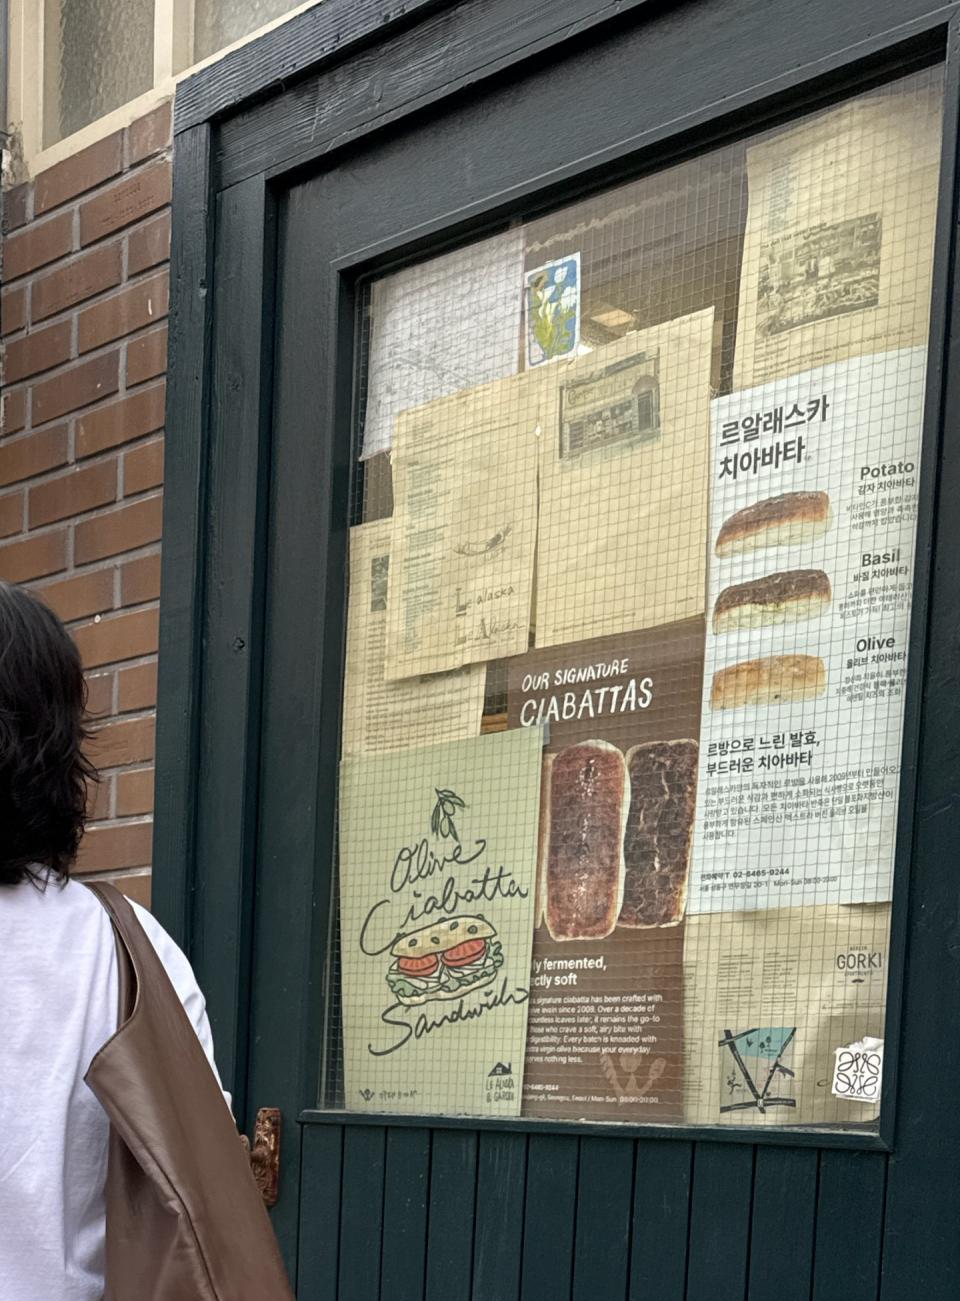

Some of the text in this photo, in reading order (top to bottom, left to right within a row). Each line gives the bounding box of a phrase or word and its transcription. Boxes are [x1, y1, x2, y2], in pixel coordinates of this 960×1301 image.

[720, 395, 829, 446] 르알래스카
[718, 437, 806, 479] 치아바타
[861, 462, 914, 480] Potato
[858, 478, 915, 495] 감자 치아바타
[862, 548, 900, 567] Basil
[854, 566, 908, 582] 바질 치아바타
[856, 636, 895, 652] Olive
[847, 651, 906, 669] 올리브 치아바타
[522, 658, 629, 692] OUR SIGNATURE
[520, 678, 653, 727] CIABATTAS
[707, 730, 820, 757] 르방으로 느린 발효,
[706, 750, 813, 777] 부드러운 치아바타
[390, 838, 487, 893] Olive
[360, 866, 529, 956] Ciabatta
[544, 956, 607, 971] fermented,
[836, 952, 883, 970] GORKI
[554, 972, 577, 985] soft
[604, 995, 620, 1003] been
[622, 994, 646, 1002] crafted
[647, 994, 663, 1002] with
[368, 976, 530, 1056] Sandwich
[598, 1005, 613, 1013] Over
[640, 1016, 660, 1024] go-to
[600, 1026, 612, 1034] airy
[564, 1036, 582, 1044] Every
[602, 1046, 617, 1054] your
[618, 1046, 651, 1055] everyday
[544, 1056, 567, 1064] nothing
